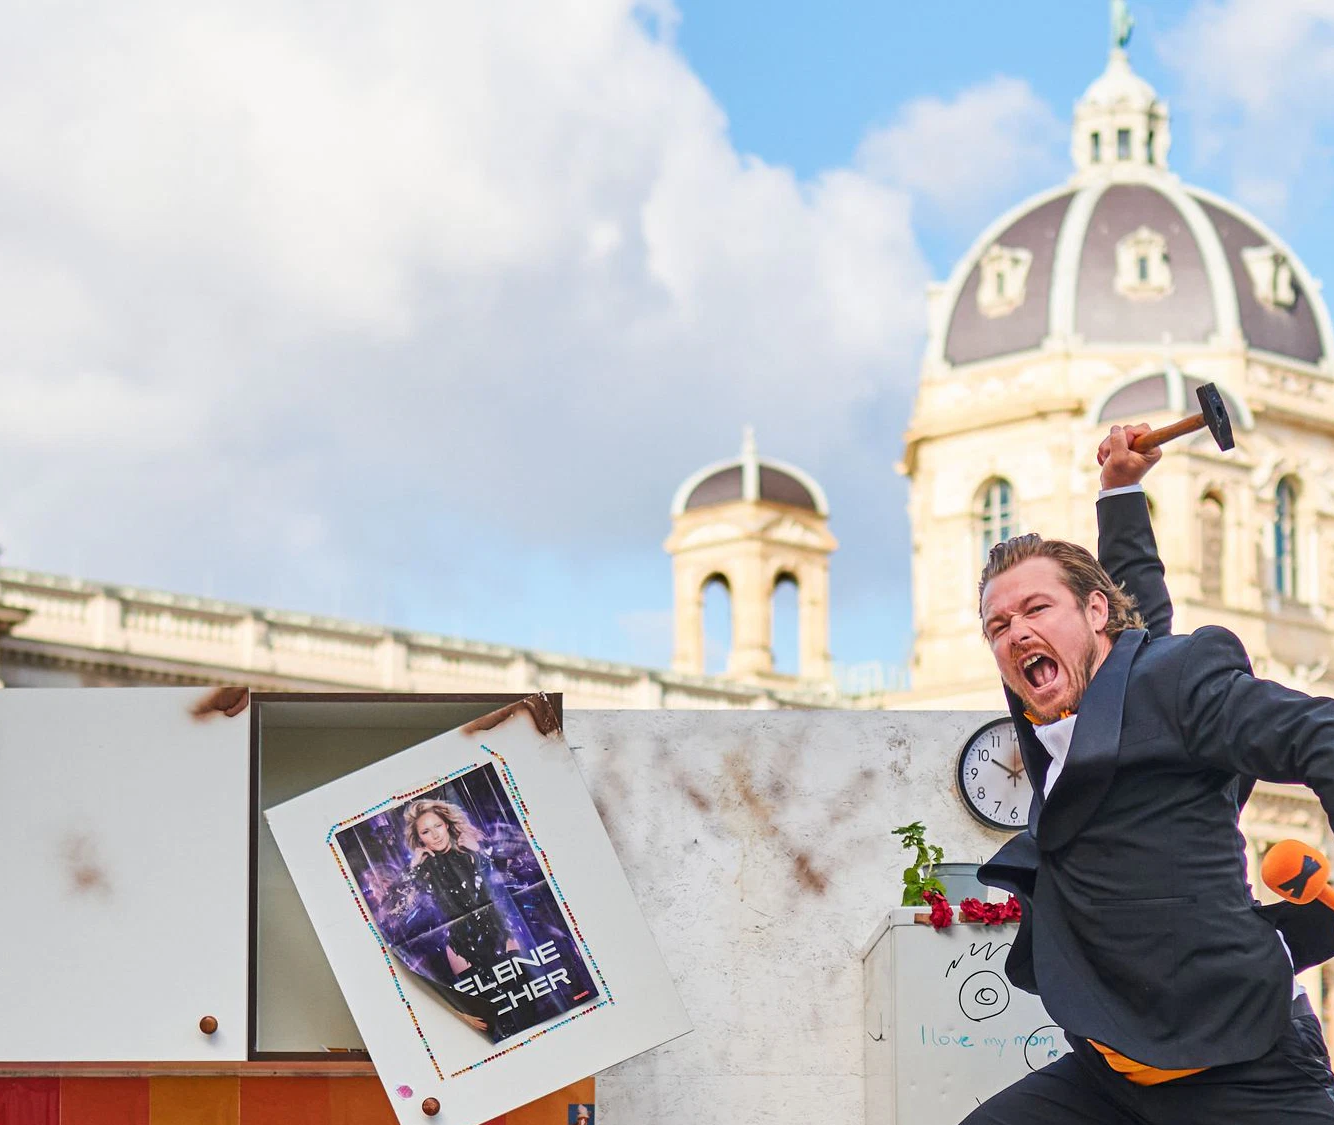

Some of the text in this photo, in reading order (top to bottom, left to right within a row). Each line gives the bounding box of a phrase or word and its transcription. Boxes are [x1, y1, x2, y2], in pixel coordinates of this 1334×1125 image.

[991, 735, 1001, 749] 11
[977, 748, 990, 762] 10
[970, 767, 979, 780] 9
[977, 786, 986, 800] 8
[994, 801, 1002, 814] 7
[1010, 806, 1019, 820] 6
[450, 940, 561, 997] ELENE
[932, 1027, 975, 1048] love
[983, 1036, 1007, 1057] my
[1014, 1034, 1055, 1048] mom
